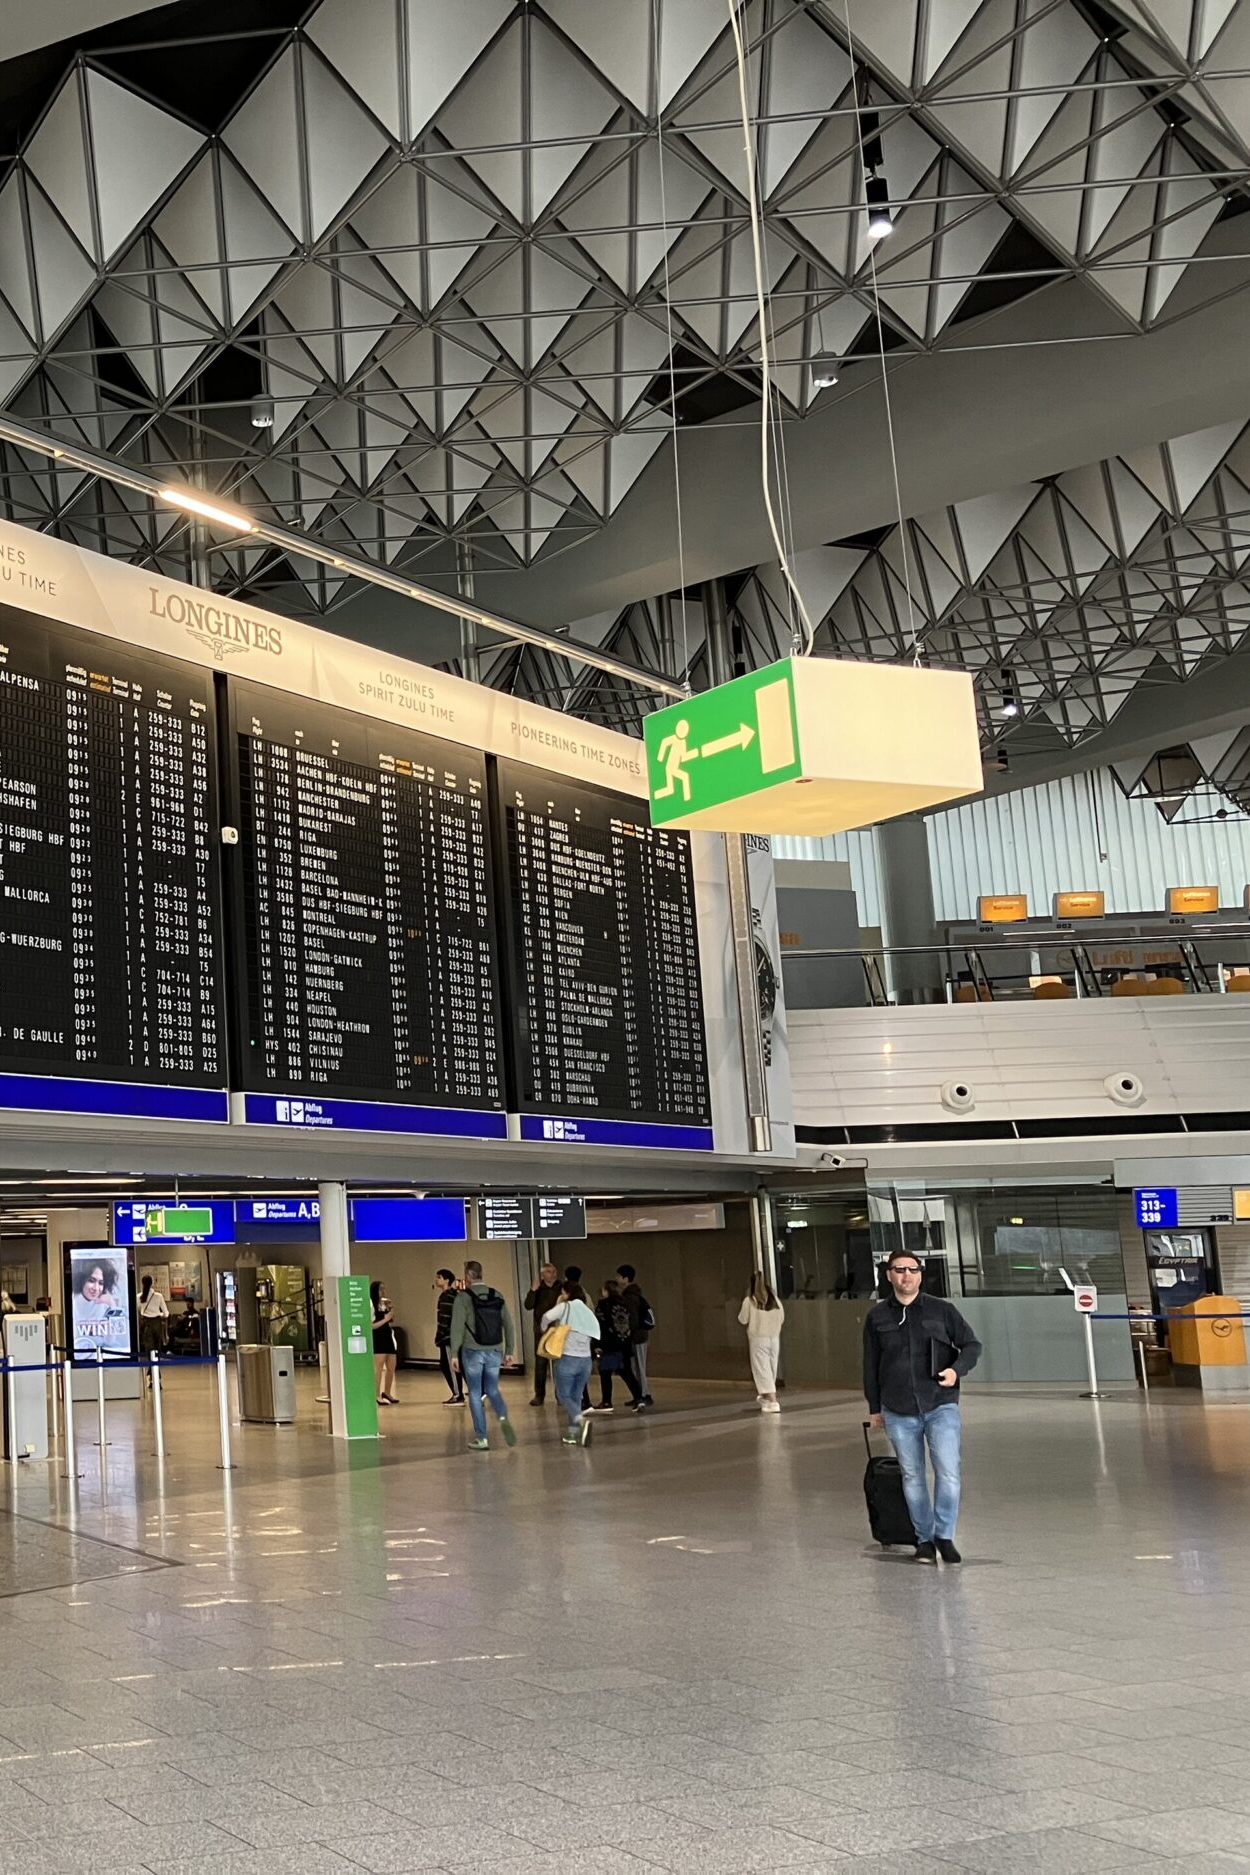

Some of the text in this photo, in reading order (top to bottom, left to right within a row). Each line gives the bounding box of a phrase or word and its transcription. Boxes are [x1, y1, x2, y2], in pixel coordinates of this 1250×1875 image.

[20, 571, 57, 597] TIME
[149, 586, 282, 655] LONGINES
[379, 671, 435, 700] LONGINES
[358, 682, 455, 723] SPIRIT ZULU TIME
[511, 721, 641, 775] PIONEERING TIME ZONES
[746, 833, 769, 853] INES
[1140, 1200, 1166, 1211] 313-
[1141, 1212, 1161, 1223] 339
[77, 1324, 109, 1336] WIN
